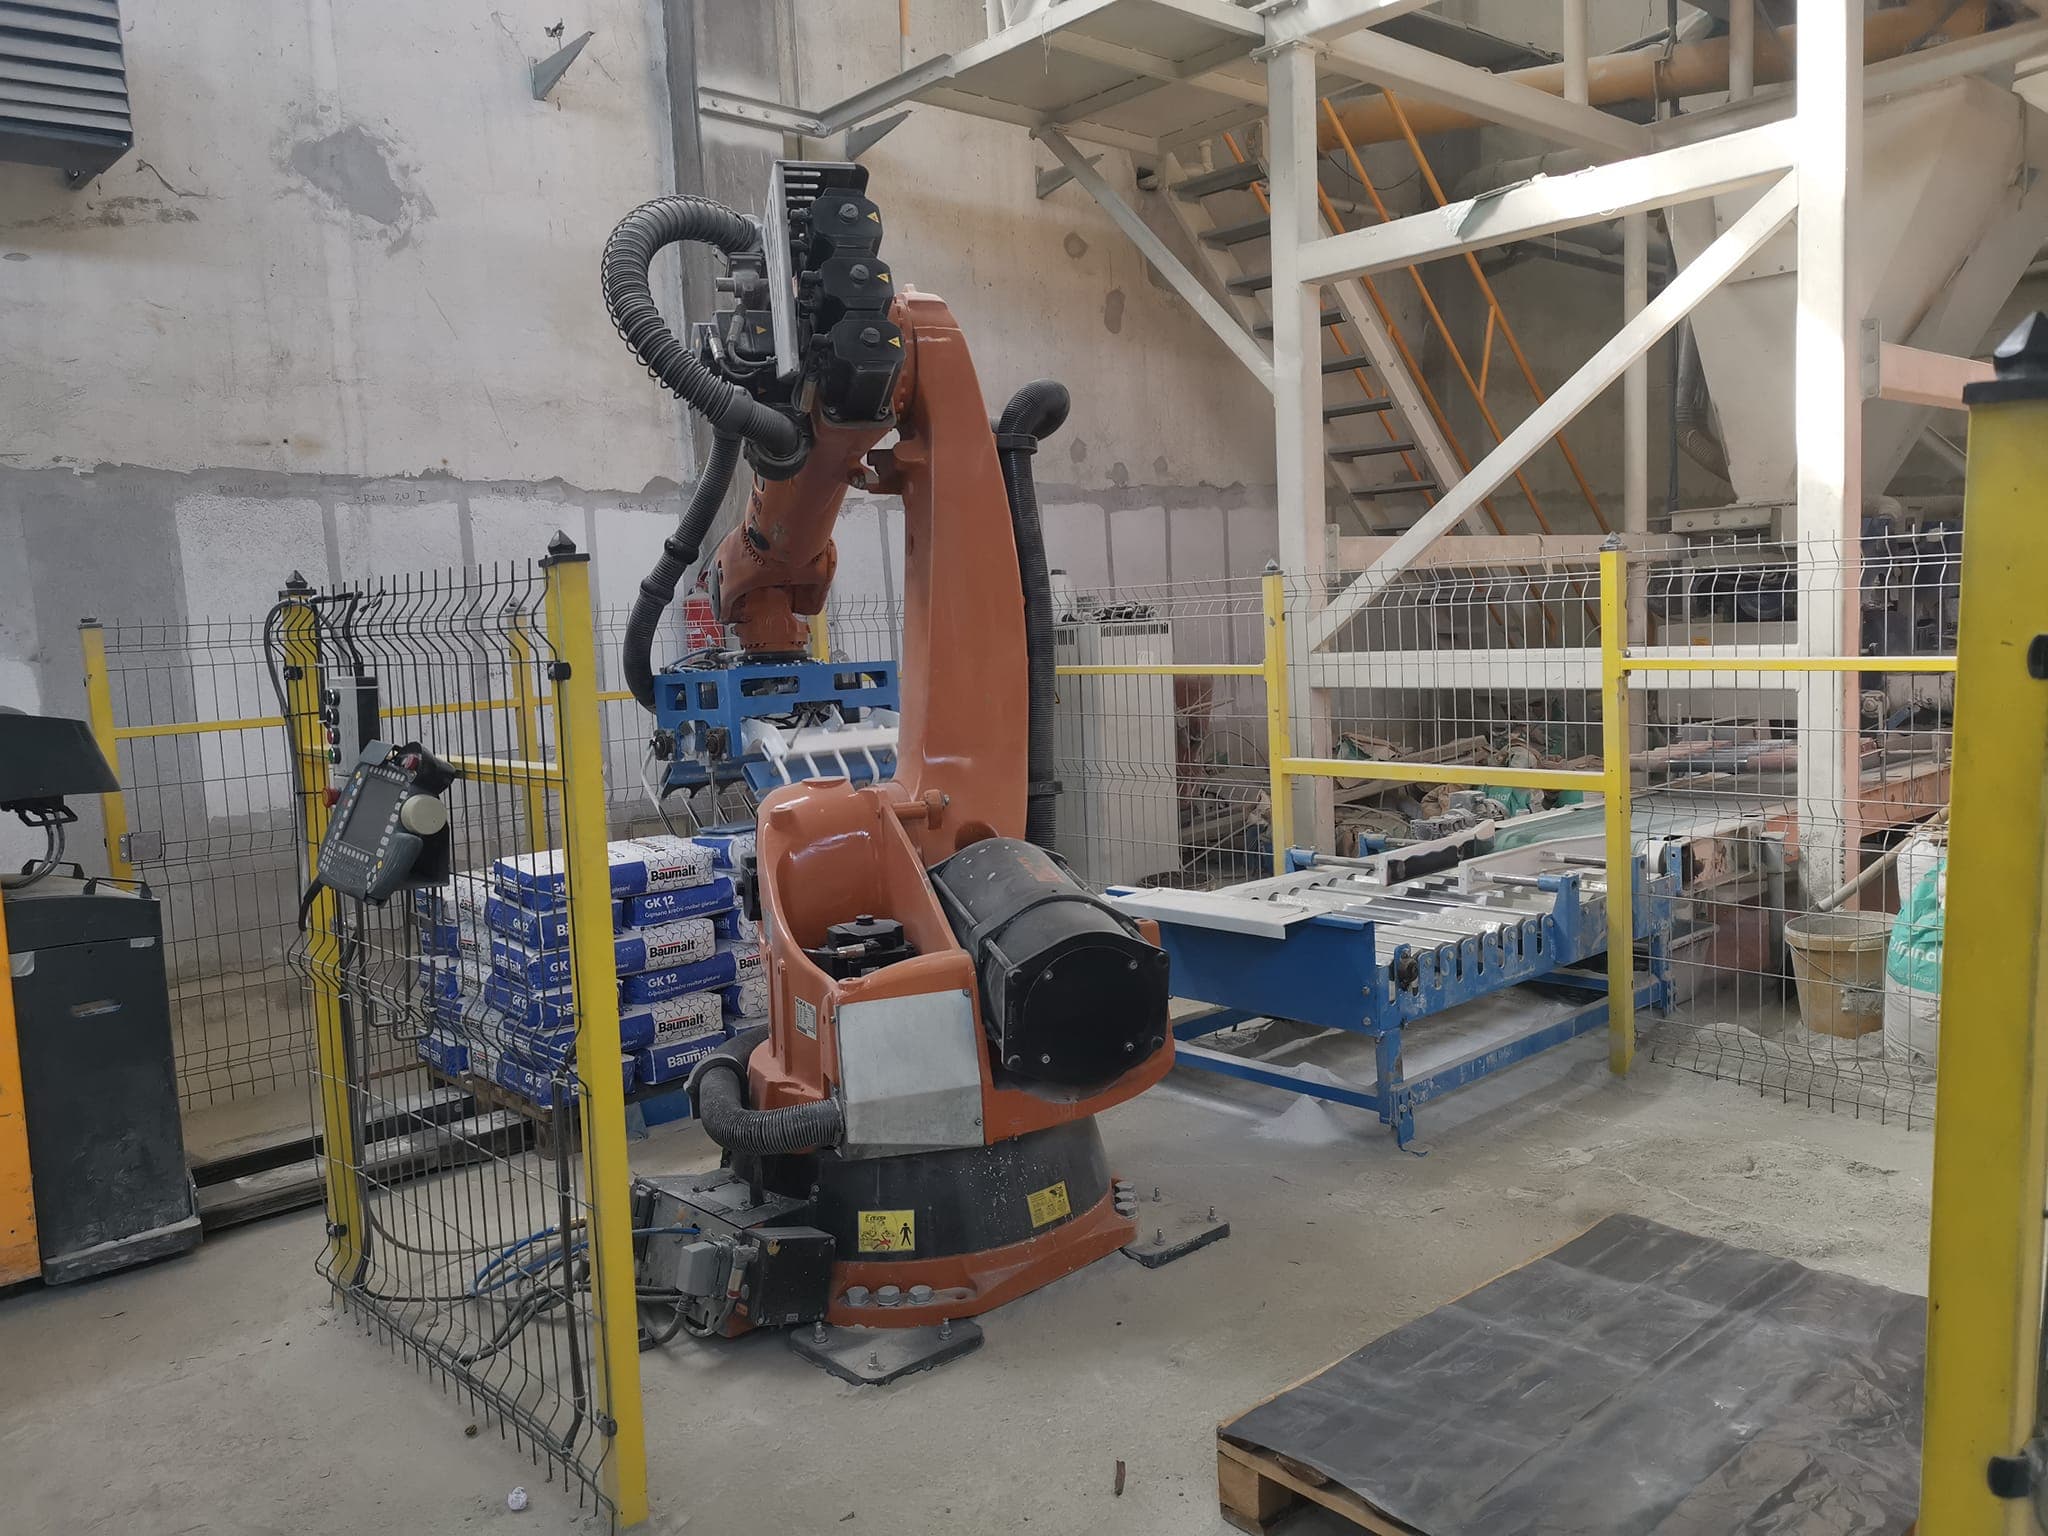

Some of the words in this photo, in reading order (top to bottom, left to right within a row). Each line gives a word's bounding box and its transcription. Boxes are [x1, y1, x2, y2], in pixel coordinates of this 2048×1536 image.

[650, 864, 697, 882] Baumält
[644, 897, 663, 909] GK
[662, 895, 675, 906] 12
[650, 939, 695, 958] Baumält
[647, 975, 664, 988] GK
[665, 973, 678, 985] 12
[658, 1013, 705, 1033] Baumält
